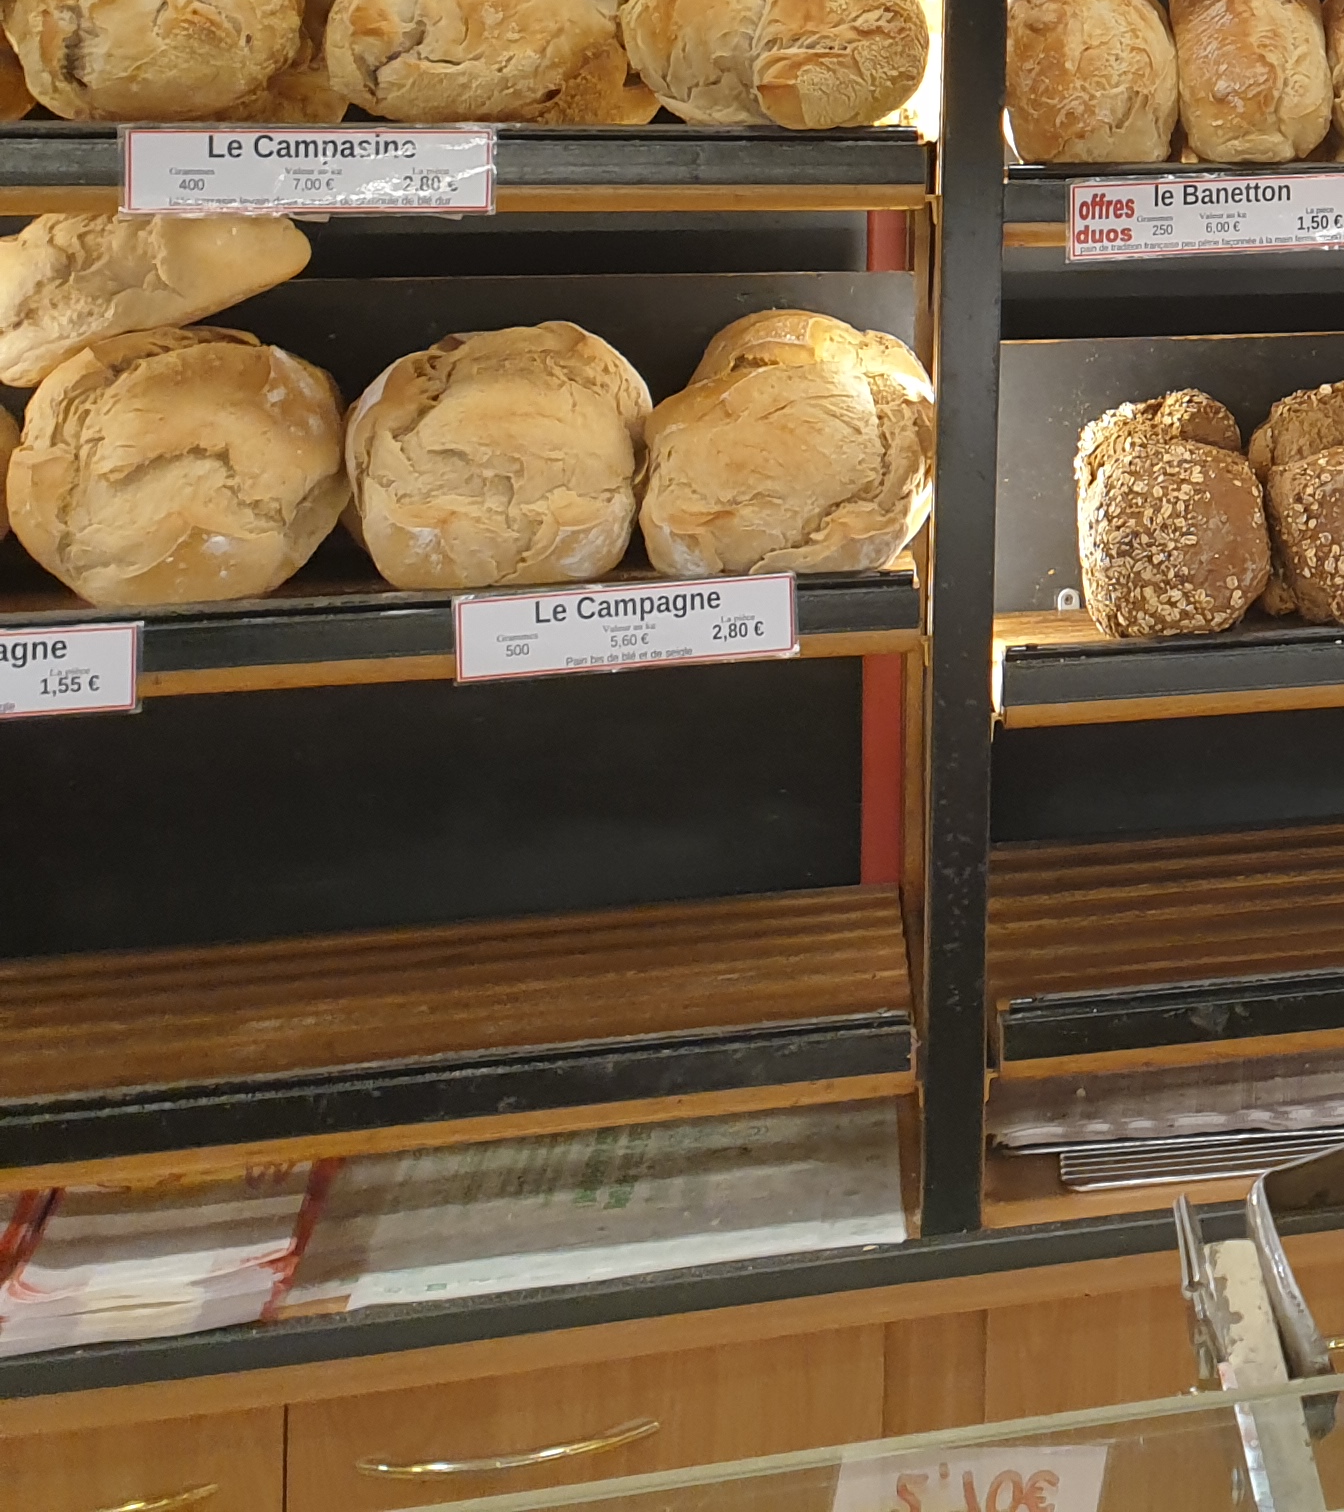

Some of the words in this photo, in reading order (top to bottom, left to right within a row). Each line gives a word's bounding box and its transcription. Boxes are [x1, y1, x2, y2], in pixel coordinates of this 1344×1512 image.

[208, 134, 243, 159] Le
[179, 178, 205, 191] 400
[293, 178, 322, 192] 7,00
[1154, 184, 1174, 207] le
[1183, 183, 1291, 206] Banetton
[1079, 193, 1135, 220] offres
[1152, 224, 1173, 236] 250
[1205, 222, 1230, 234] 6,00
[1297, 215, 1330, 231] 1,50
[1334, 214, 1343, 229] €
[1076, 225, 1133, 244] duos
[535, 600, 567, 623] Le
[576, 589, 721, 621] Campagne
[712, 621, 748, 642] 2,80
[754, 620, 764, 637] €
[505, 643, 530, 657] 500
[610, 633, 637, 649] 5,60
[40, 676, 82, 697] 1,55
[88, 675, 100, 691] €
